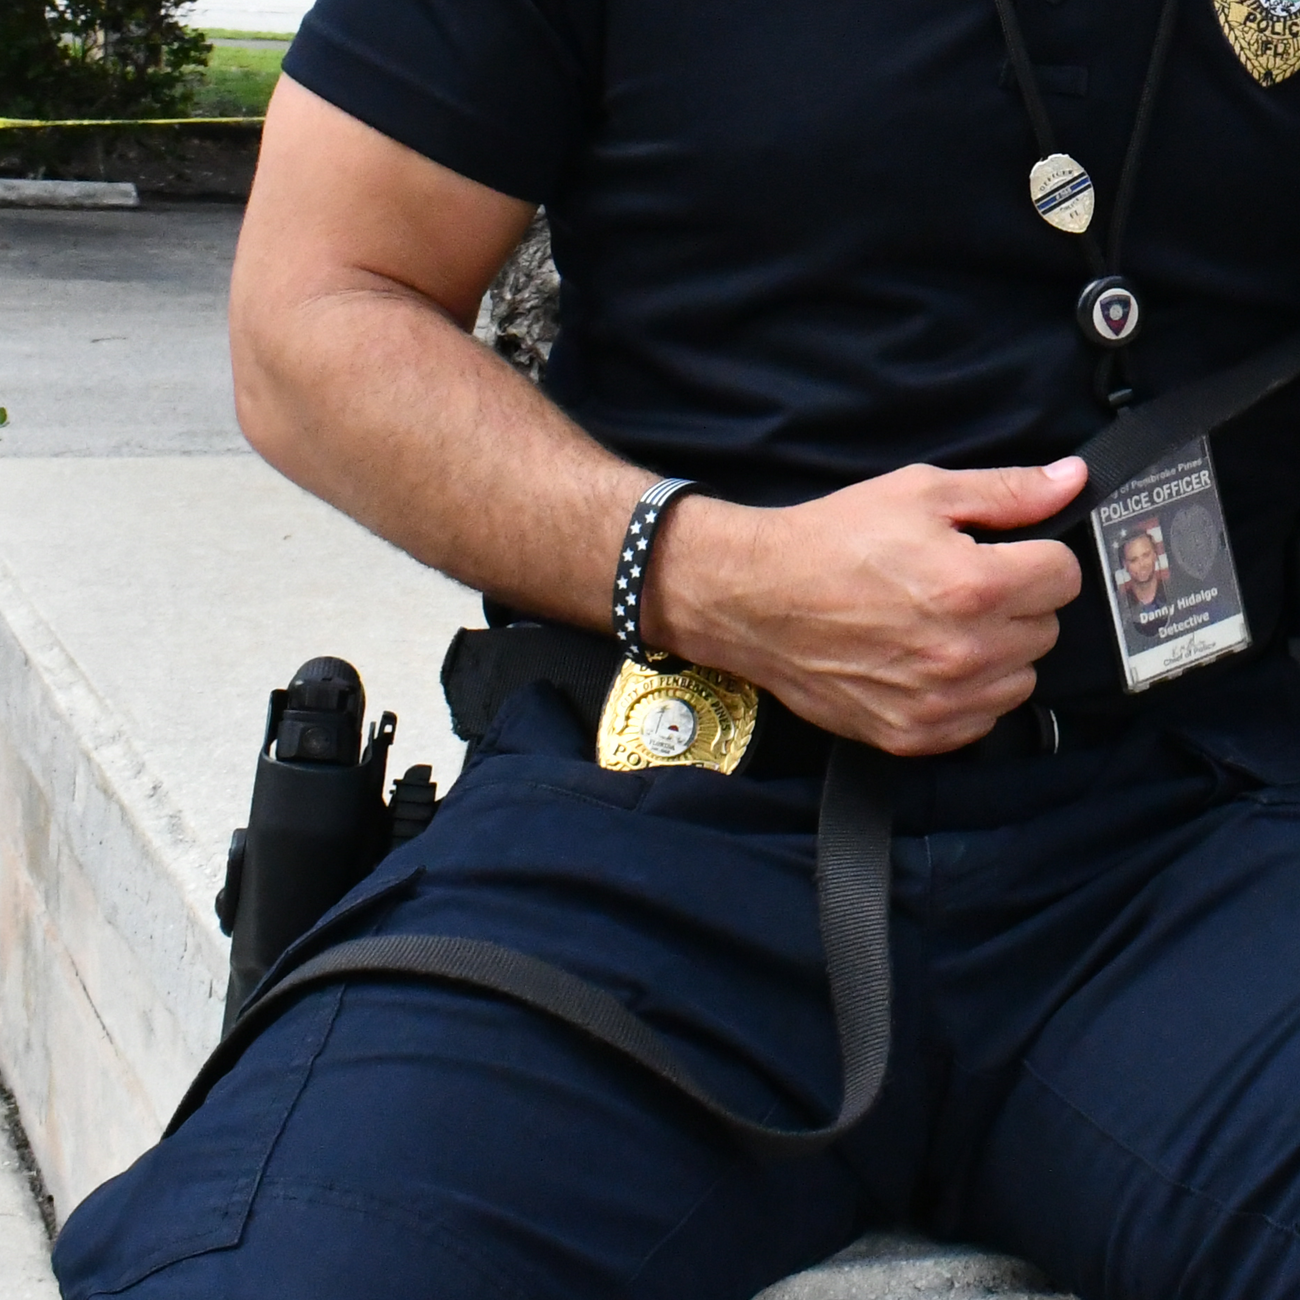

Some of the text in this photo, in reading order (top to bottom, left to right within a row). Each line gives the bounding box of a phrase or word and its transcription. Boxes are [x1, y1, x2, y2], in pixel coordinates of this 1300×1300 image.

[1100, 469, 1211, 523] POLICE OFFICER
[1140, 587, 1218, 625] Danny Hidalgo
[1158, 611, 1210, 639] Detective
